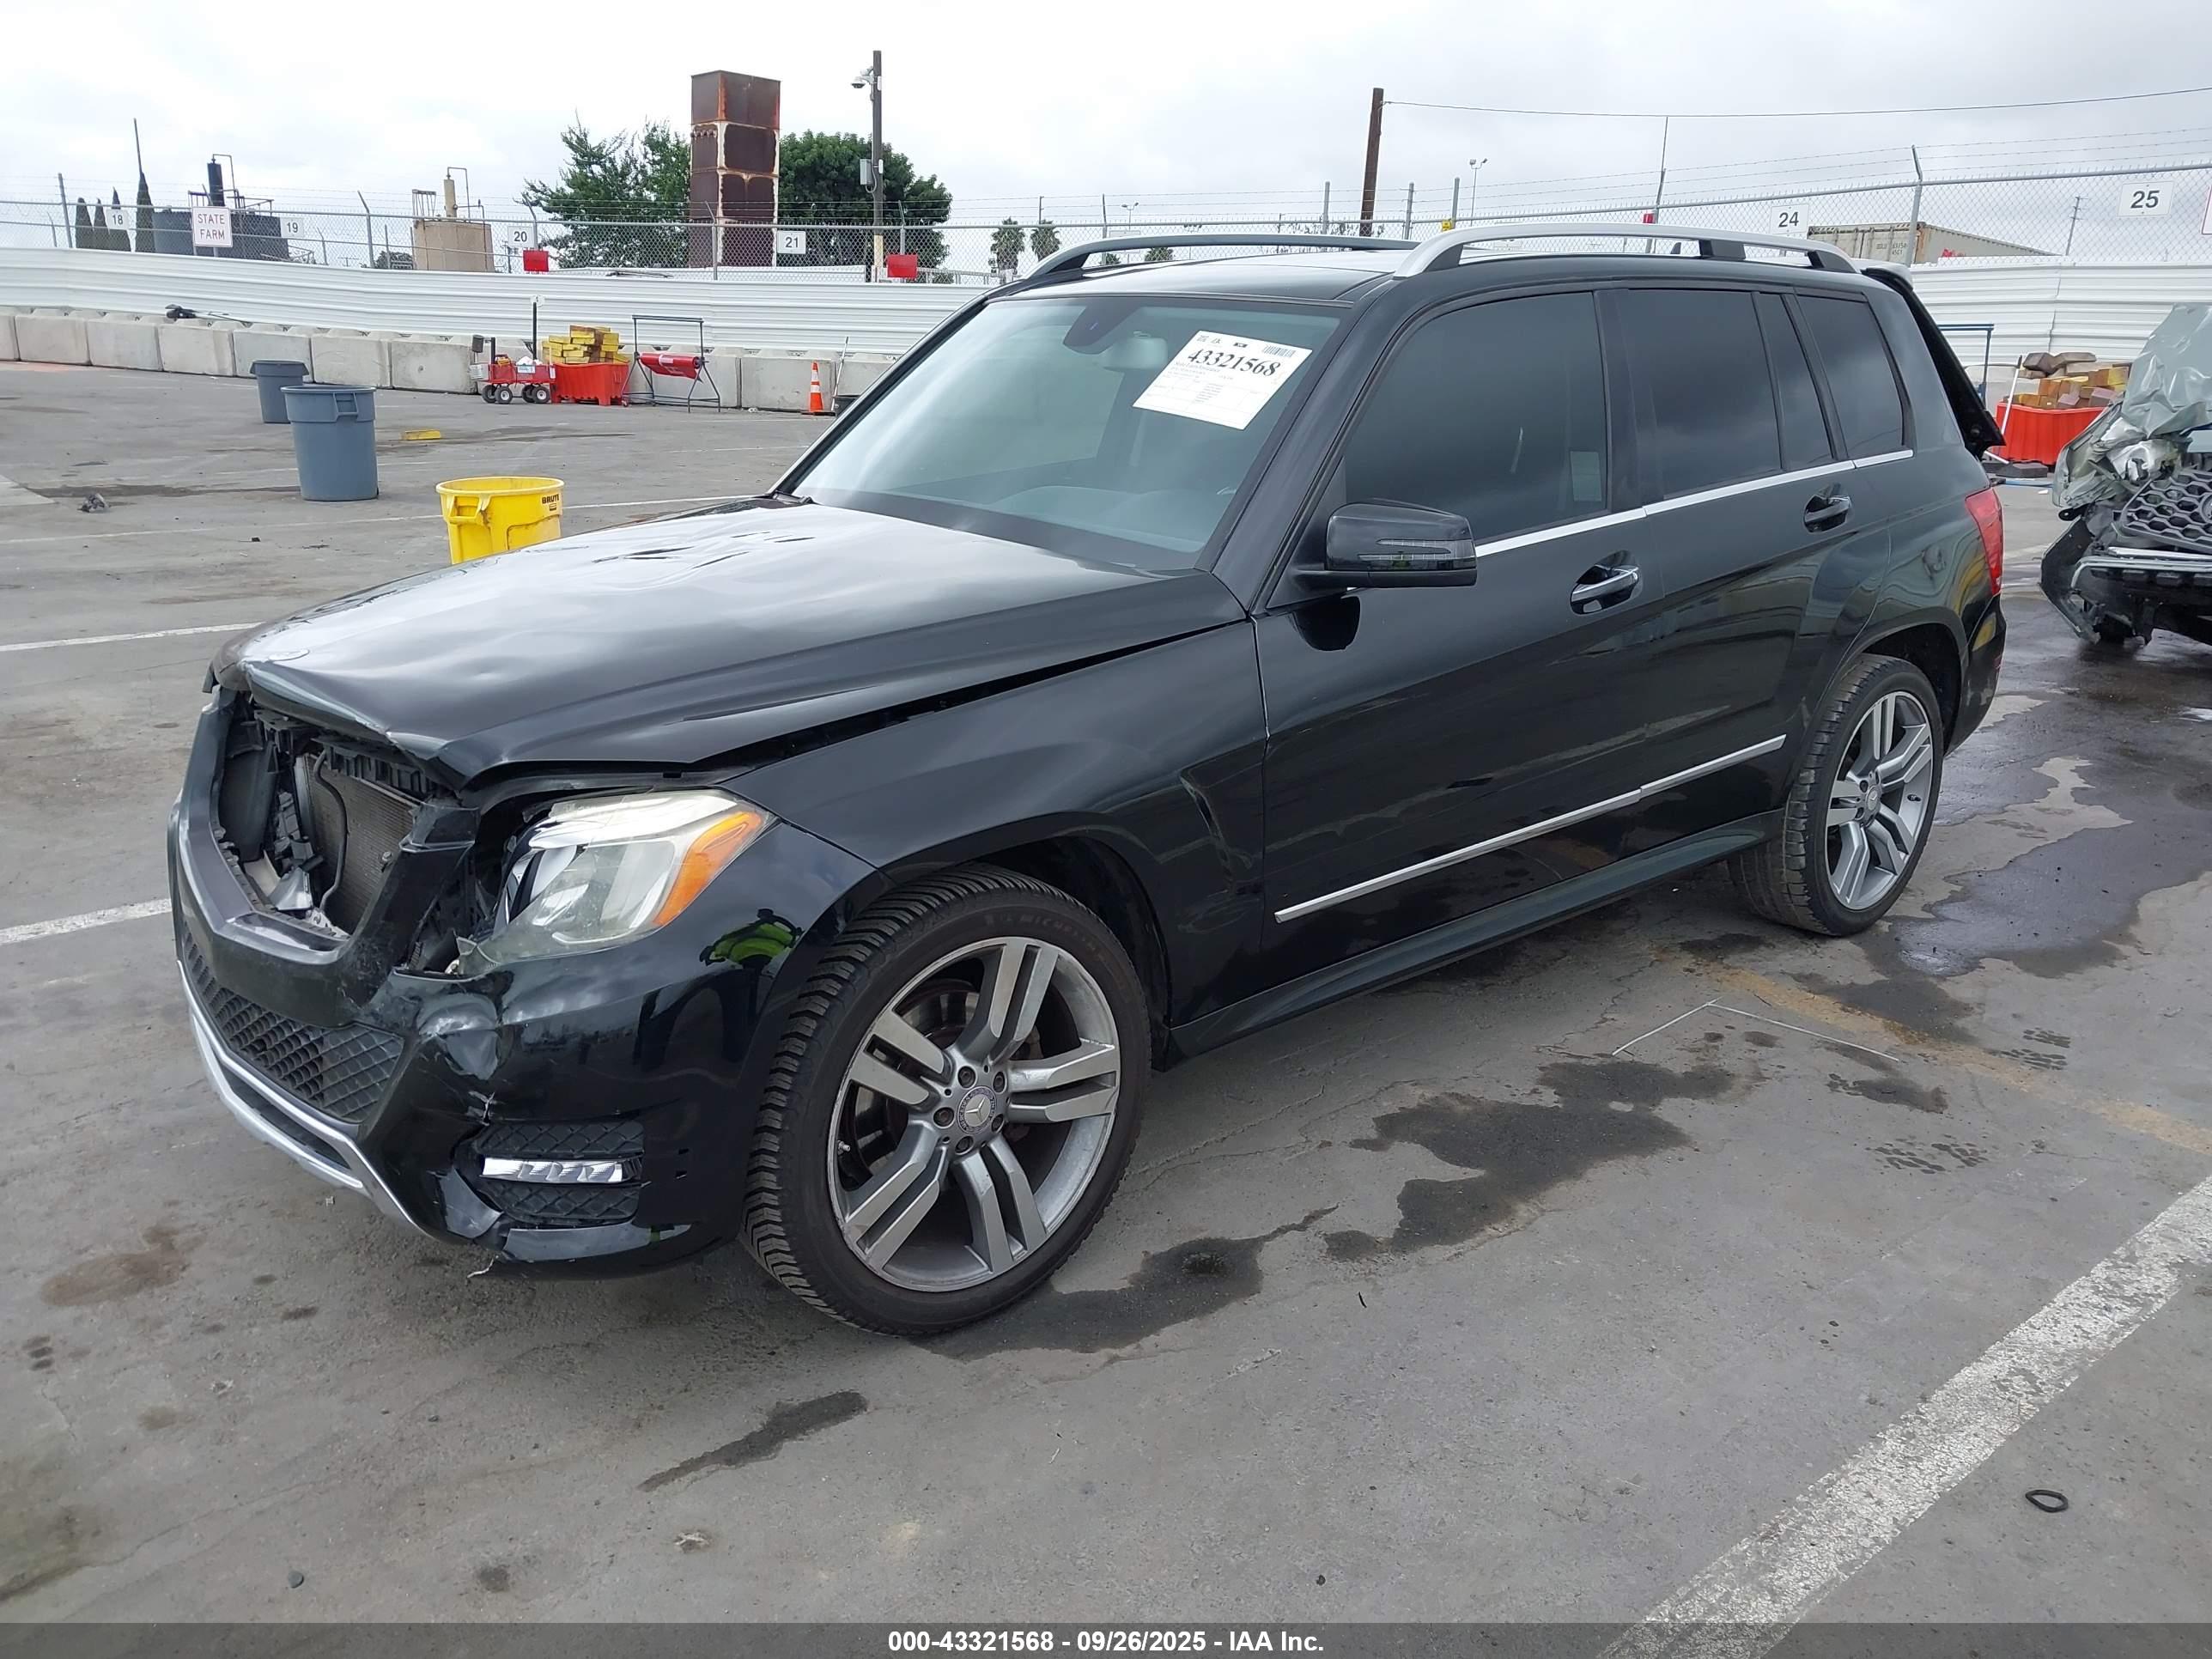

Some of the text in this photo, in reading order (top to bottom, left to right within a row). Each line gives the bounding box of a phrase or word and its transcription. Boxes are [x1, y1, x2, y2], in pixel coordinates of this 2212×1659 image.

[2130, 190, 2160, 209] 25
[112, 214, 124, 225] 18
[198, 214, 226, 225] STATE
[1778, 211, 1800, 228] 24
[200, 228, 225, 240] FARM
[286, 222, 299, 234] 19
[513, 230, 527, 242] 20
[785, 234, 800, 249] 21
[1188, 349, 1281, 376] 43321568
